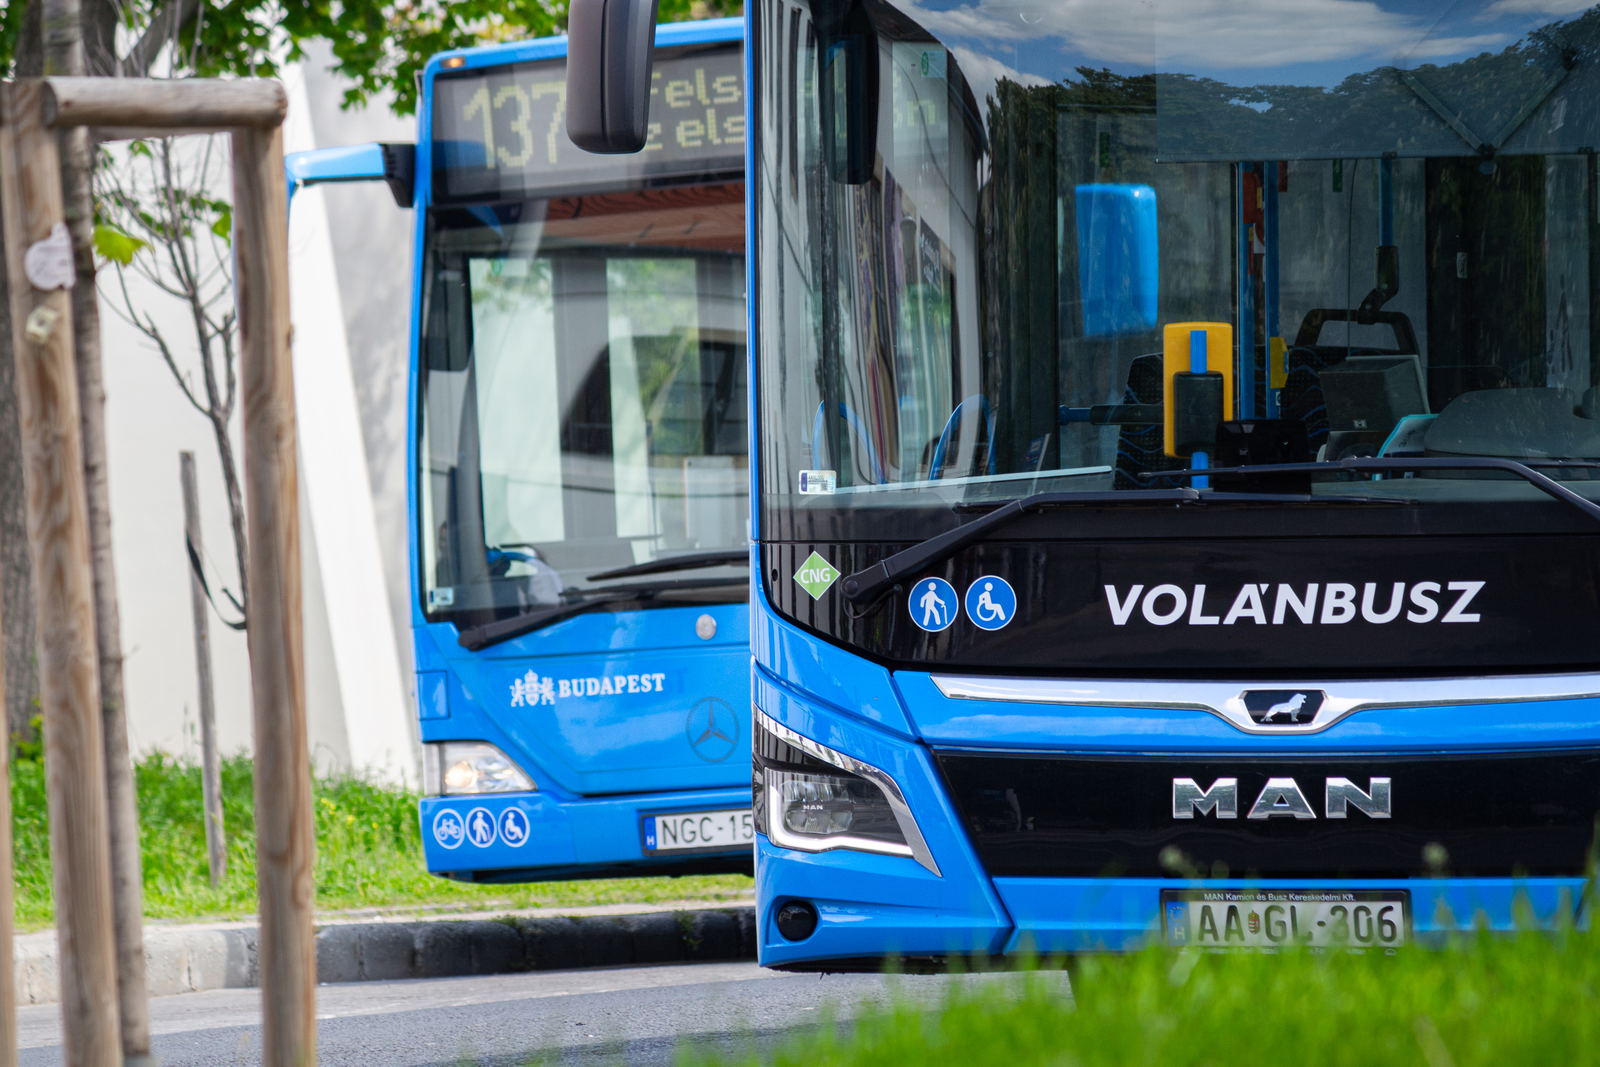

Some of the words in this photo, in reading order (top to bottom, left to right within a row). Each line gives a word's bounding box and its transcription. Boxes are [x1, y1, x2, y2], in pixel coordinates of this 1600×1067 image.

[463, 81, 568, 170] 137
[800, 567, 831, 584] CNG
[1104, 581, 1486, 626] VOLÁNBUSZ
[558, 672, 666, 698] BUDAPEST
[1172, 776, 1392, 819] MAN
[646, 835, 655, 846] H
[662, 814, 753, 846] NGC-15
[1203, 892, 1224, 901] MAN
[1225, 892, 1254, 901] Kamion
[1268, 892, 1287, 901] Busz
[1198, 904, 1246, 942] AA
